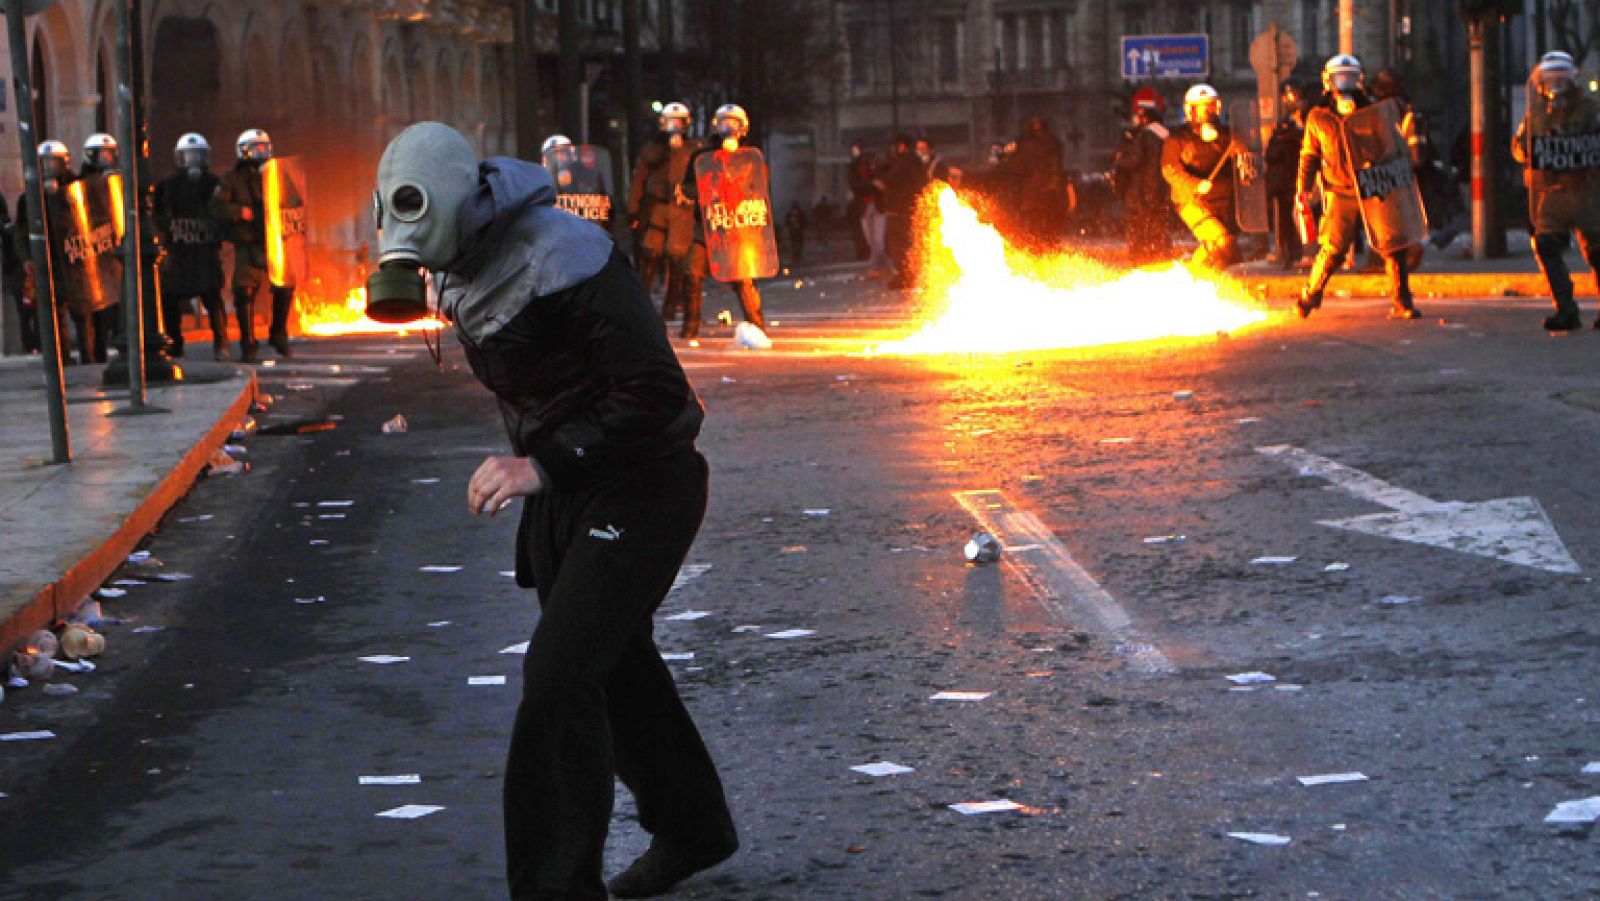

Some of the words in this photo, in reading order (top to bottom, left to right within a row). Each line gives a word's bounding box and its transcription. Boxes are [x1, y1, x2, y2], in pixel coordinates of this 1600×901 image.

[1539, 150, 1600, 169] POLIC
[567, 206, 609, 220] LICE
[711, 213, 767, 232] POLICE
